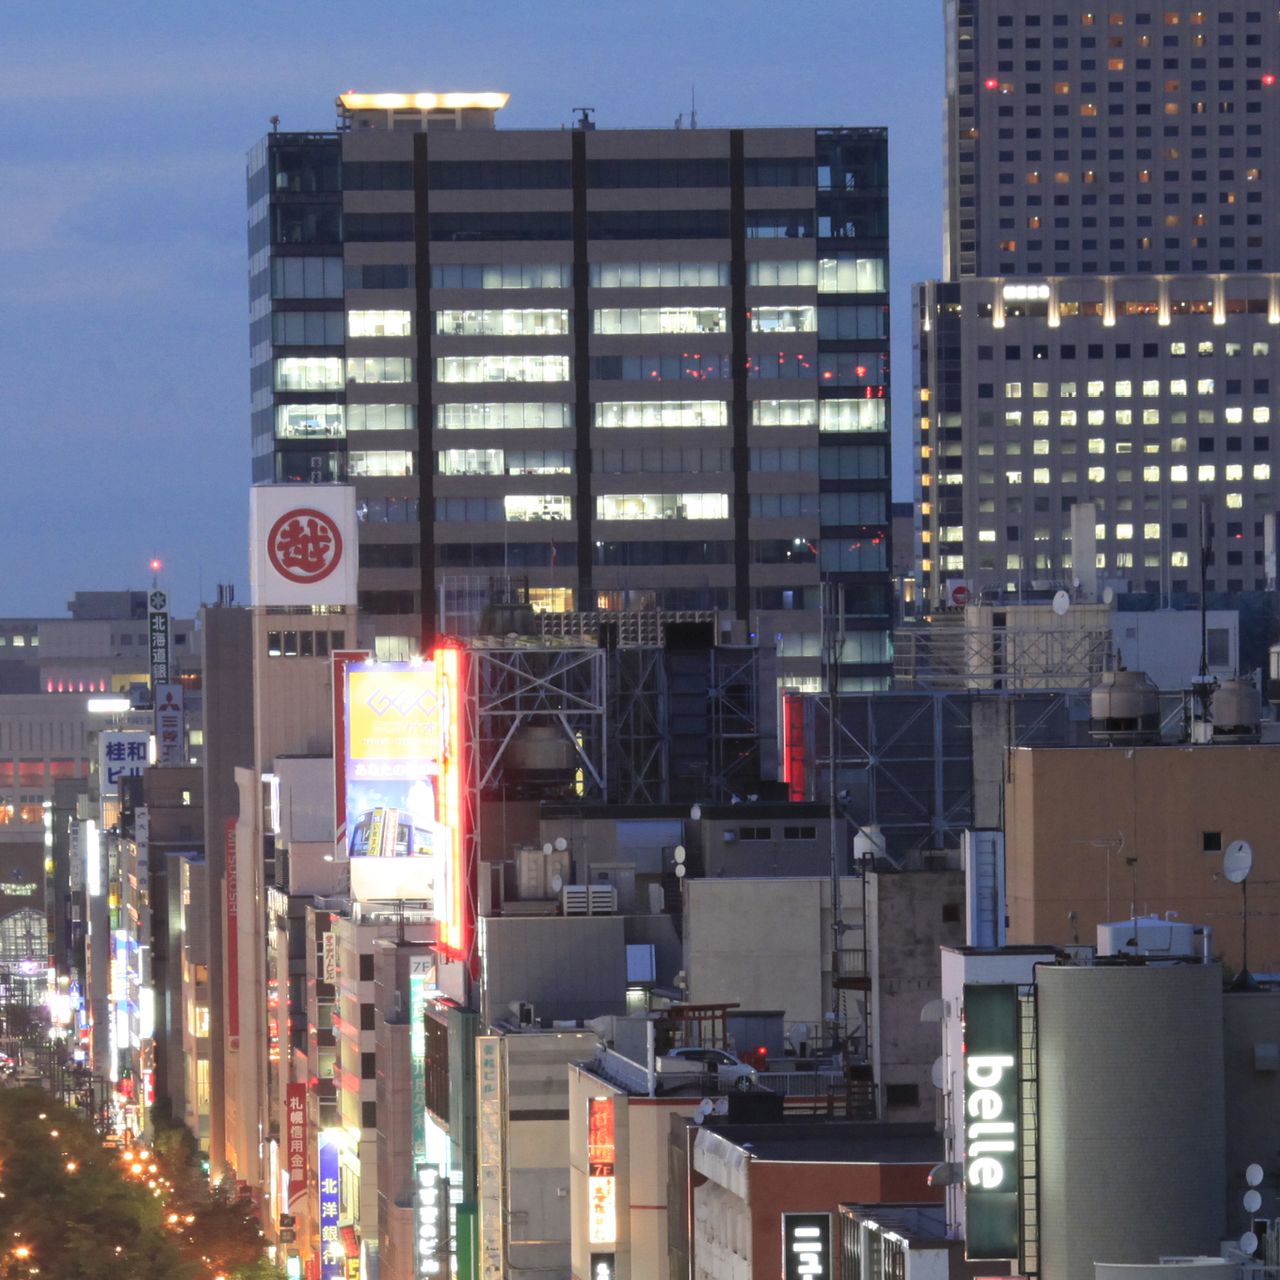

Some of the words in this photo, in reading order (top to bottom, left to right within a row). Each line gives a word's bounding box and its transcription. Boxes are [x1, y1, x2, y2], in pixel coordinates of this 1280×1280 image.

[152, 615, 167, 684] 北海道銀
[106, 741, 147, 761] 桂和
[413, 961, 430, 973] 7F
[289, 1096, 304, 1181] 札幌信用金庫
[967, 1055, 1015, 1189] belle
[594, 1163, 612, 1176] 7F
[321, 1177, 338, 1265] 北洋銀行
